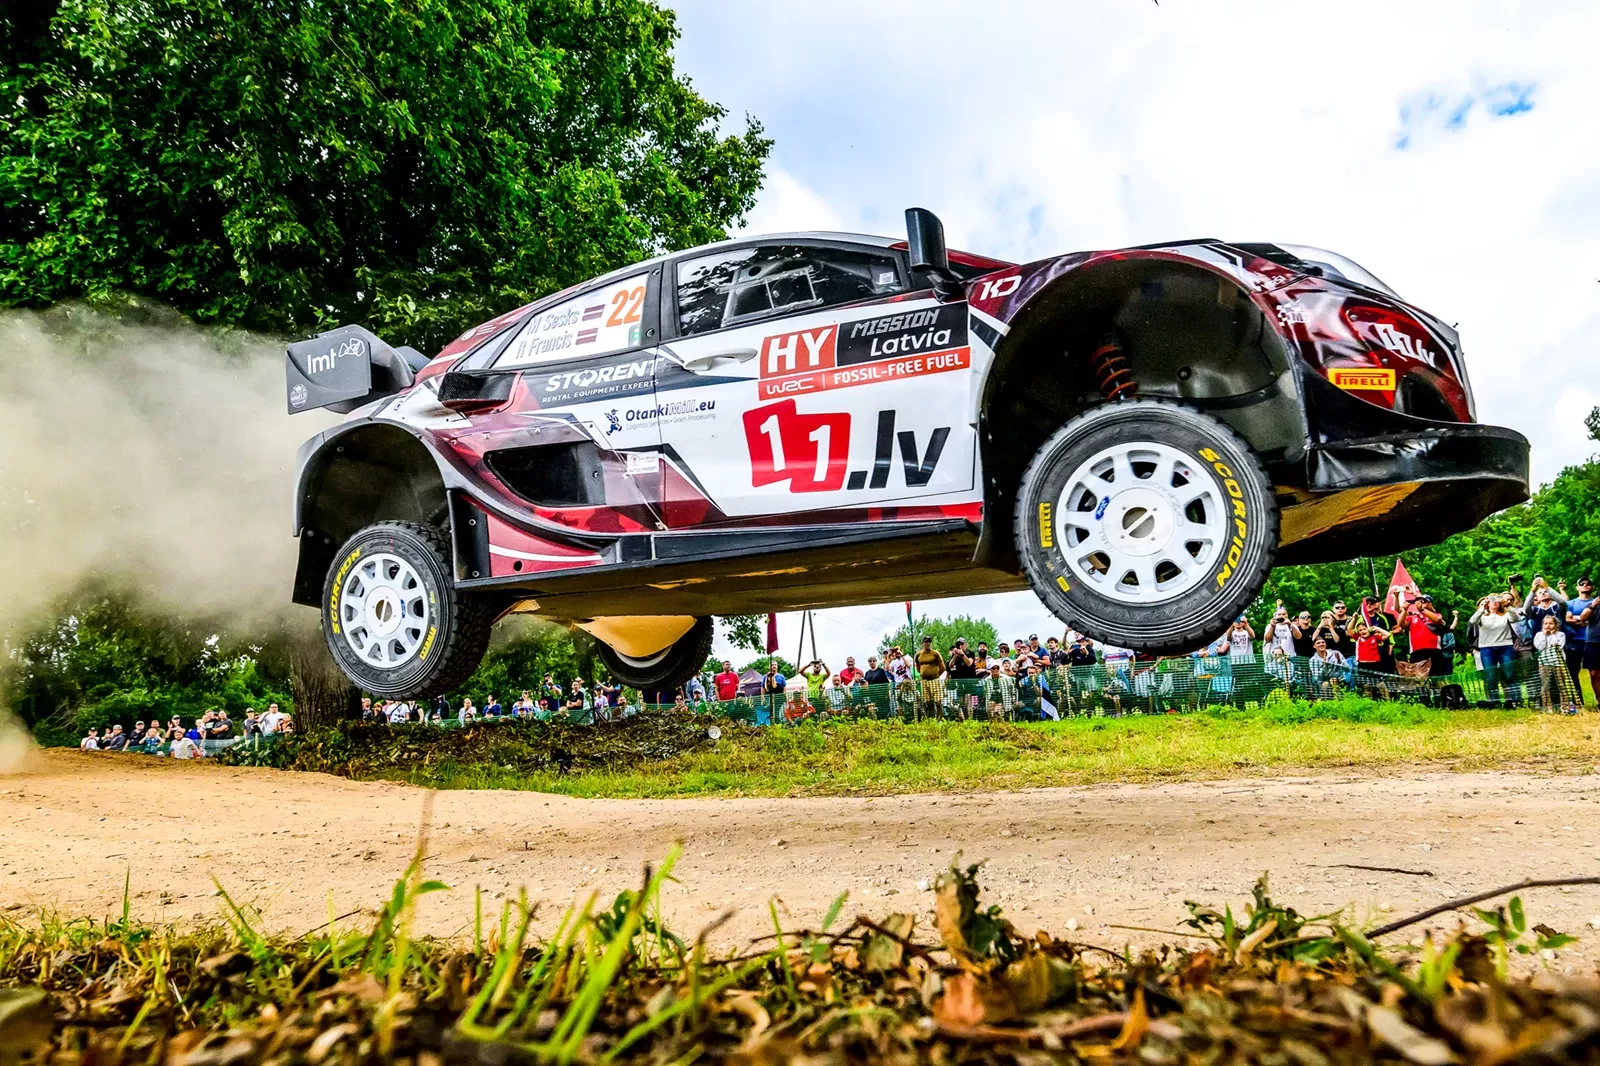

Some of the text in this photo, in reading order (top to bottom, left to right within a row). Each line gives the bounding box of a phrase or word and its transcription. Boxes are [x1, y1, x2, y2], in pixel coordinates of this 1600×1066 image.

[606, 286, 646, 327] 22
[527, 309, 580, 335] M Sesks
[851, 308, 940, 338] MISSION
[516, 330, 574, 359] R Francis
[767, 328, 833, 373] HY
[870, 327, 951, 357] Latvia
[307, 348, 337, 374] lmt
[545, 358, 664, 392] STORENT
[766, 353, 963, 394] WRC FOSSIL-FREE FUEL
[542, 379, 659, 403] RENTAL EQUIPMENT EXPERTS
[1335, 372, 1389, 386] PIRELLI
[626, 399, 716, 421] OtankiMill.eu
[760, 409, 951, 490] 11.lv
[1199, 447, 1248, 589] SCORPION
[331, 548, 362, 634] SCORPION
